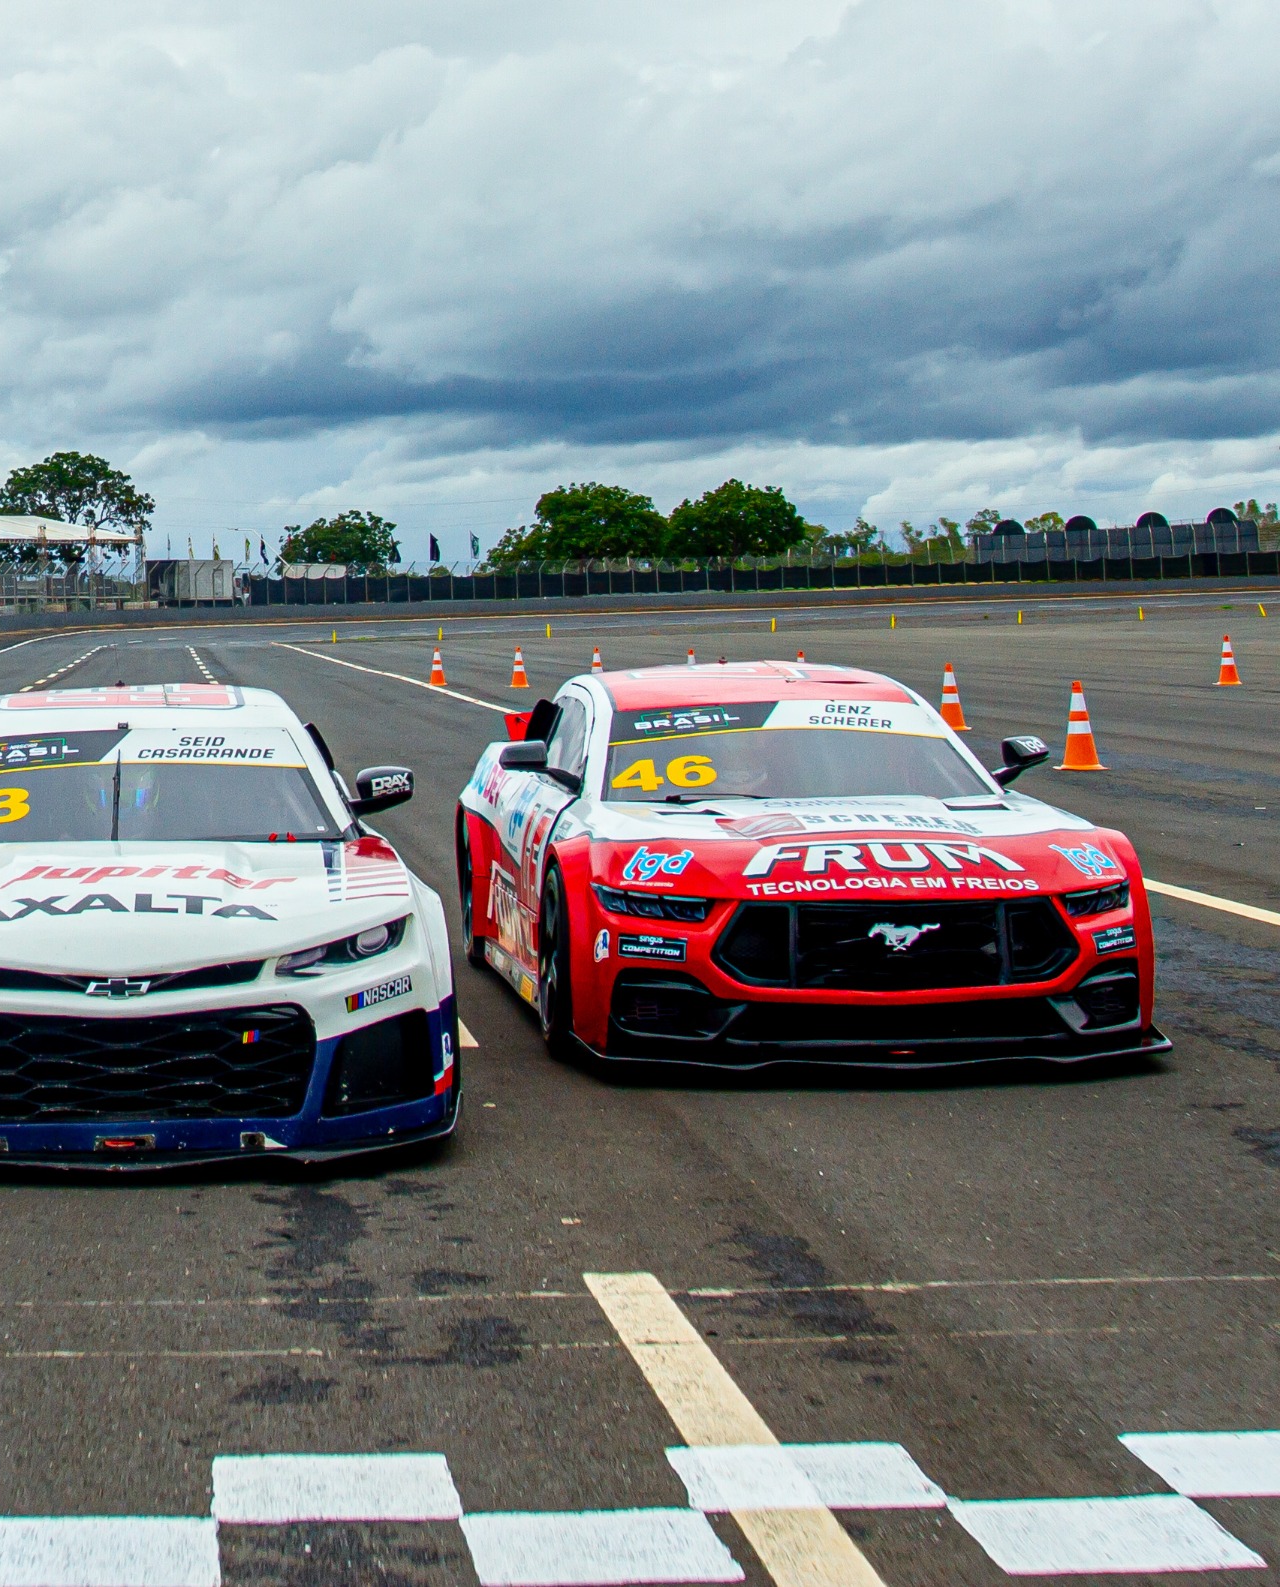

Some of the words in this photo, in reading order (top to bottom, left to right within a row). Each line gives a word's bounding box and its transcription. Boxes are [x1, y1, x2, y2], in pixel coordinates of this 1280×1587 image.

[824, 704, 872, 715] GENZ
[633, 713, 740, 730] BRASIL
[808, 715, 892, 728] SCHERER
[178, 736, 225, 747] SEID
[137, 748, 276, 760] CASAGRANDE
[371, 772, 410, 790] DRAX
[611, 754, 718, 792] 46
[622, 846, 695, 881] tgd
[742, 838, 1027, 877] FRUM
[0, 865, 299, 890] Jupiter
[746, 877, 908, 896] TECNOLOGIA
[911, 877, 947, 889] EM
[953, 877, 1040, 891] FREIOS
[639, 935, 664, 946] singus
[622, 944, 681, 957] COMPETITION
[362, 976, 411, 1007] NASCAR
